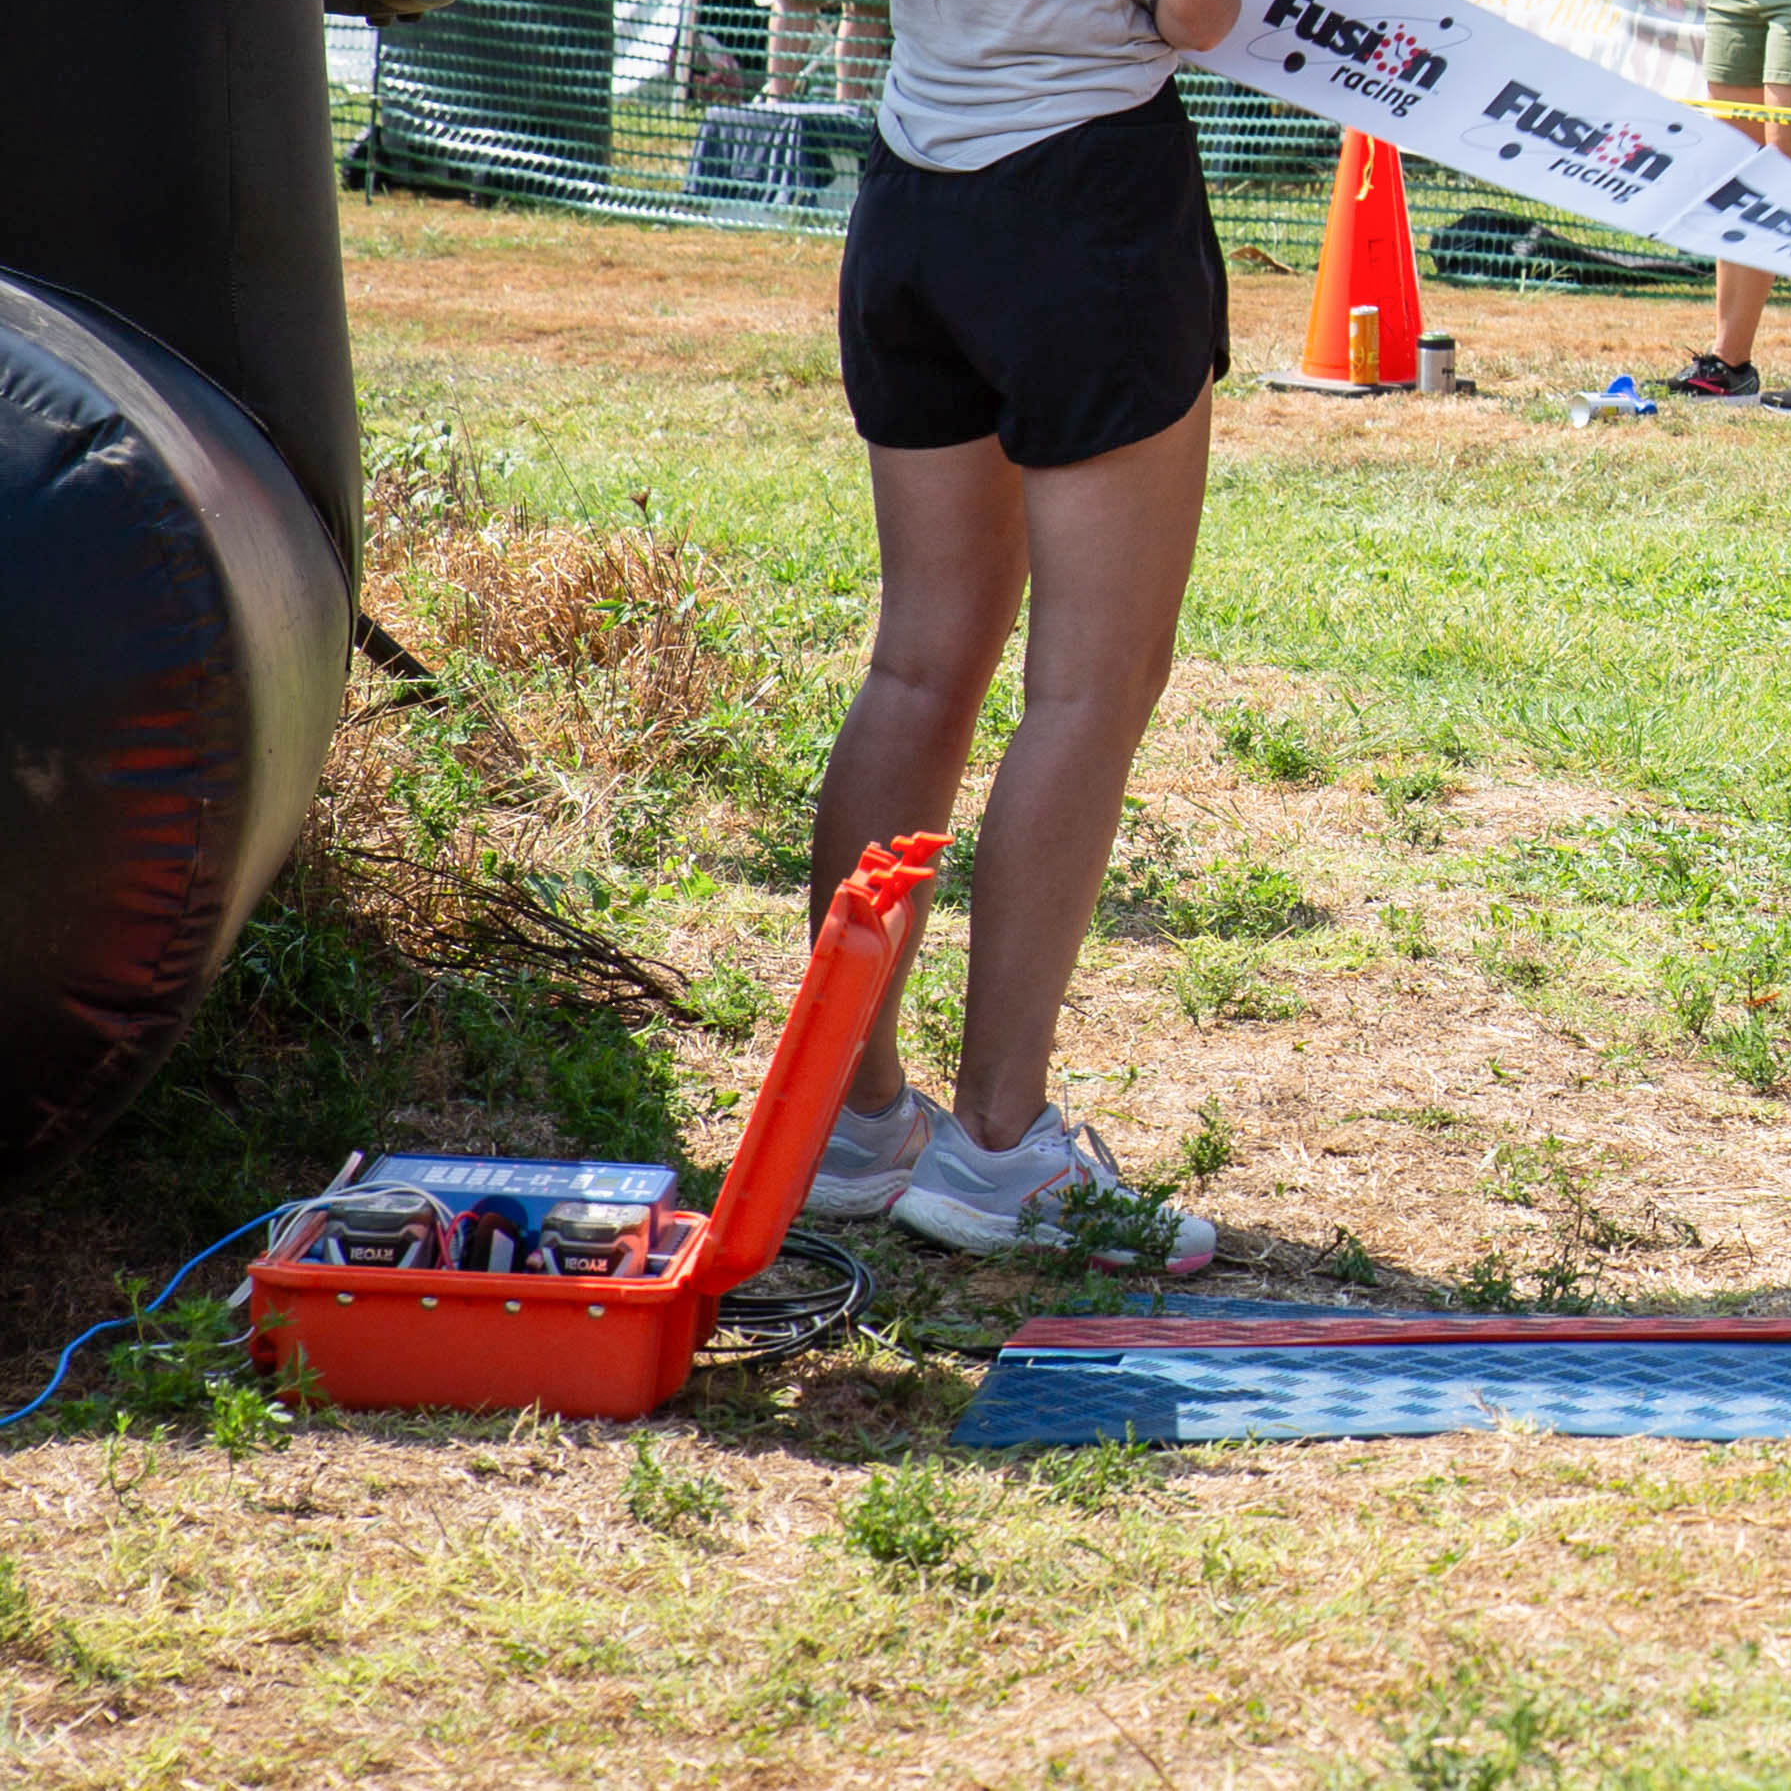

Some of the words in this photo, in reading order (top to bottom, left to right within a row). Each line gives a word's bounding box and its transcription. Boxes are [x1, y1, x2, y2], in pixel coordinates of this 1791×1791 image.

[1330, 64, 1423, 118] racing
[1481, 78, 1675, 182] Fusion
[1547, 158, 1646, 205] racing
